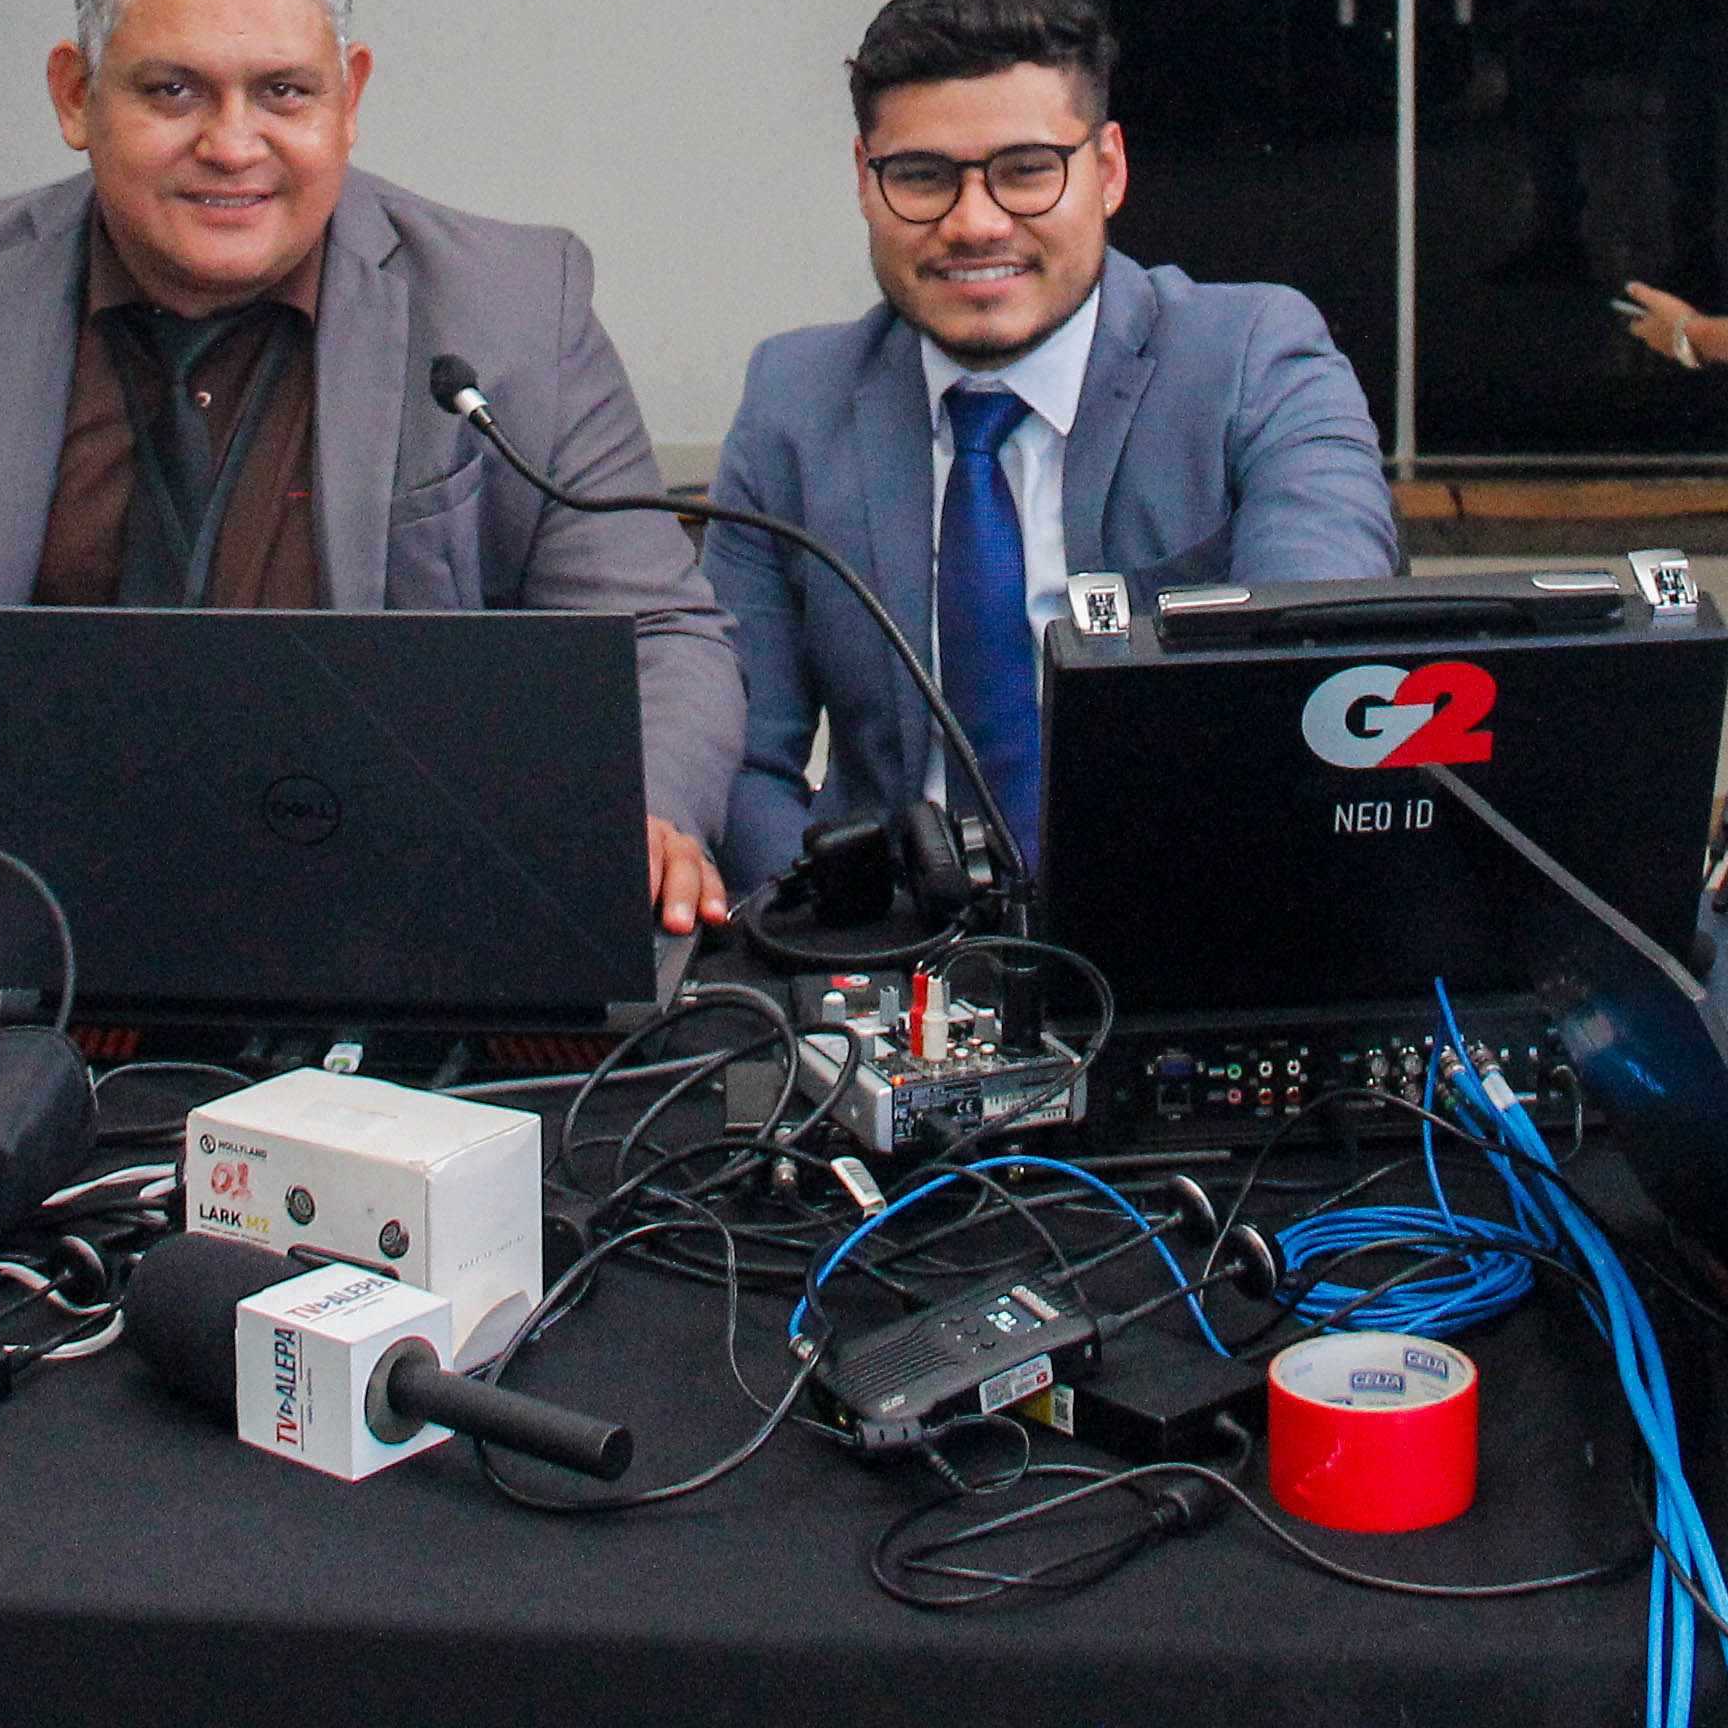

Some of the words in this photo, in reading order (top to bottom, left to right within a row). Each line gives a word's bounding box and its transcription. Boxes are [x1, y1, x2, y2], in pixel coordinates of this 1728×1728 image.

[1302, 661, 1498, 769] G2
[1333, 801, 1393, 834] NEO
[1404, 798, 1435, 830] iD
[218, 1138, 268, 1159] HOLLYLAND
[199, 1203, 242, 1227] LARK
[245, 1214, 271, 1233] M2
[274, 1327, 298, 1401] ALEPA
[1406, 1350, 1448, 1377] CELTA
[1353, 1372, 1403, 1390] CELTA
